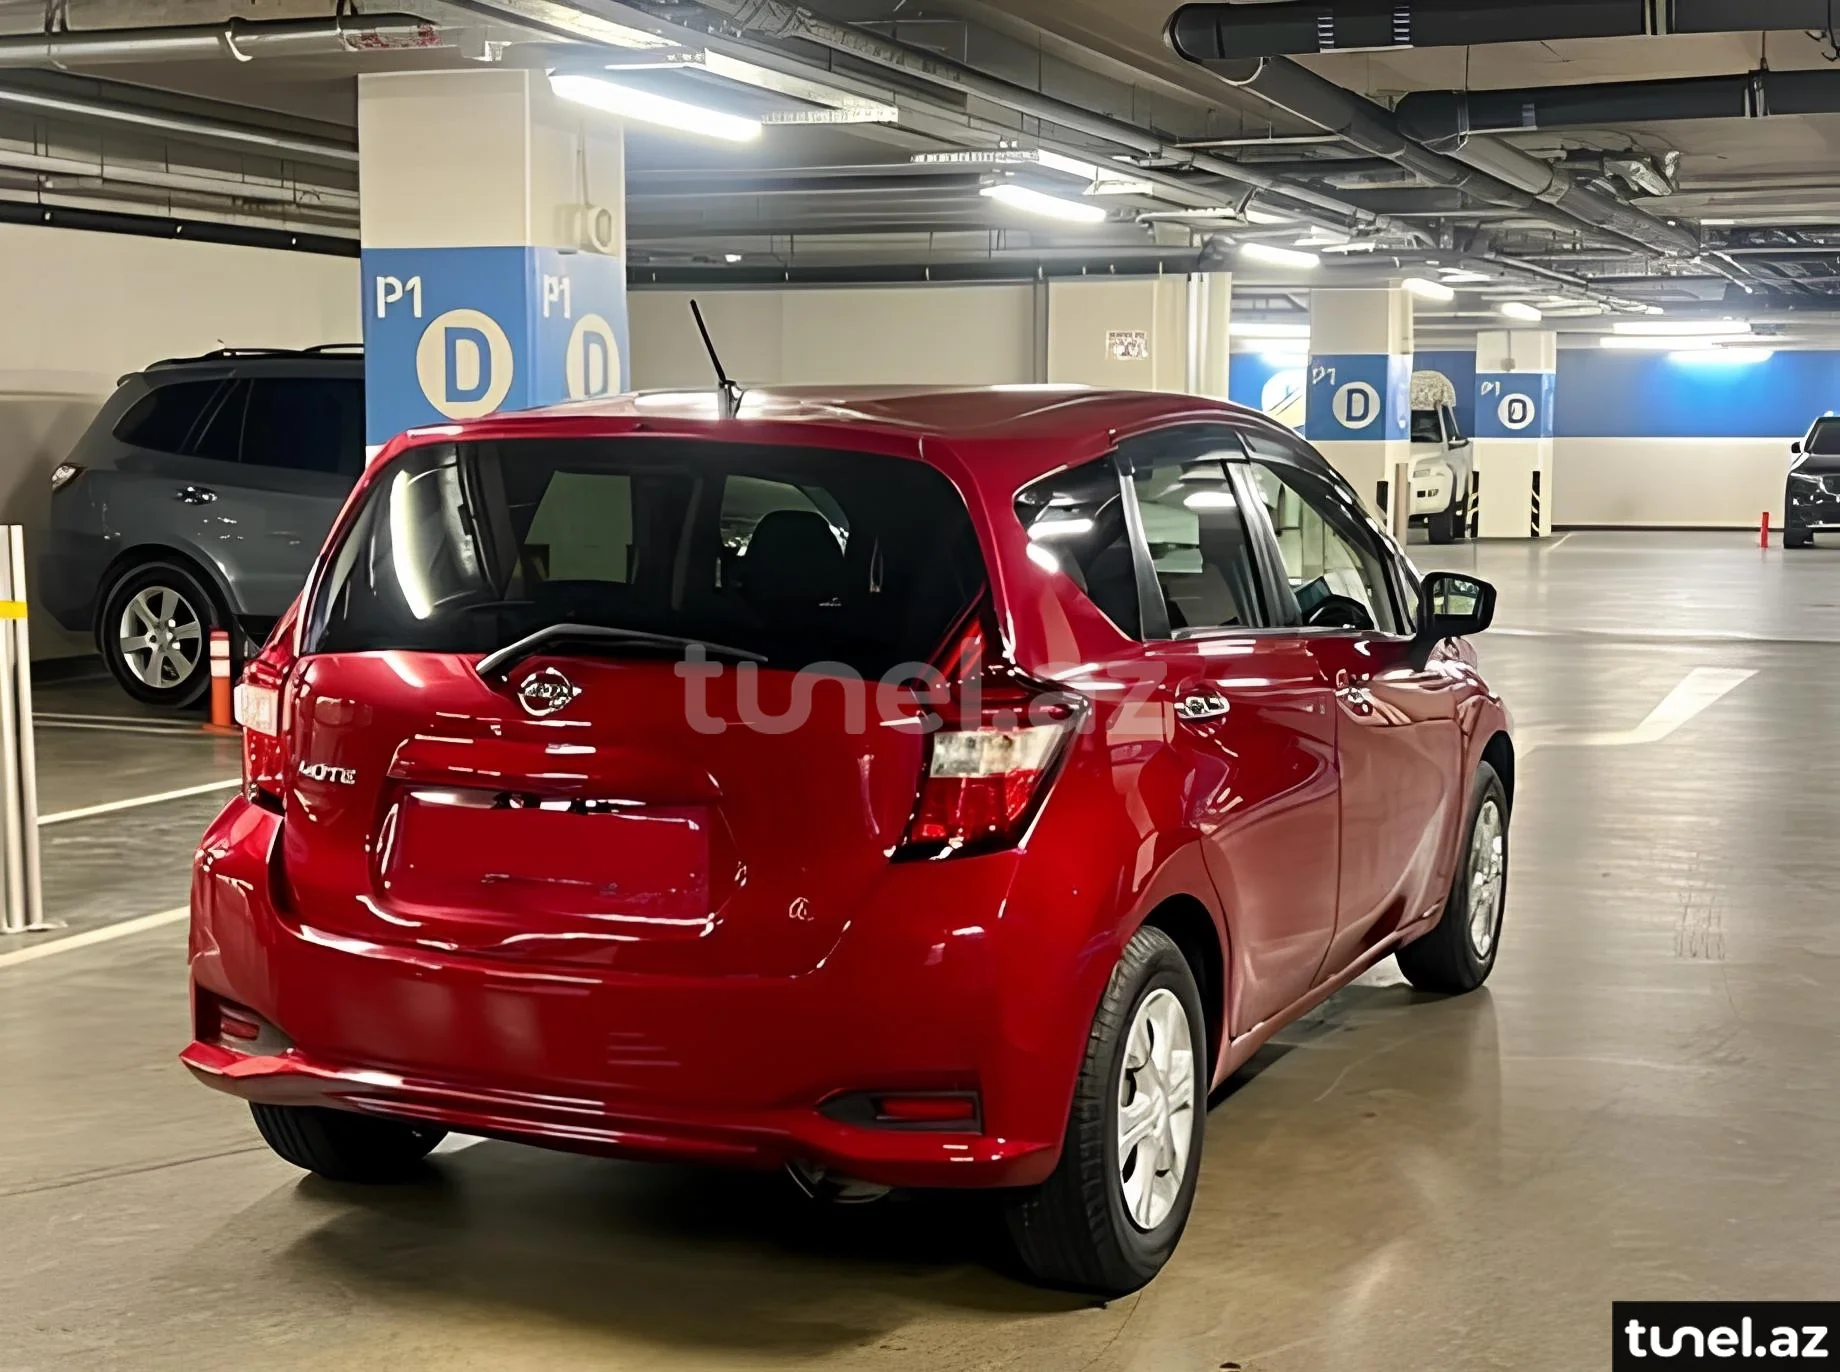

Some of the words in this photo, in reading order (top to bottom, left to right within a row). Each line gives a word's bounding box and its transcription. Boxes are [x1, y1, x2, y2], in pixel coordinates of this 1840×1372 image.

[376, 275, 422, 318] P1
[543, 274, 571, 319] P1
[444, 326, 492, 402] D
[582, 330, 609, 396] D
[1346, 388, 1370, 421] D
